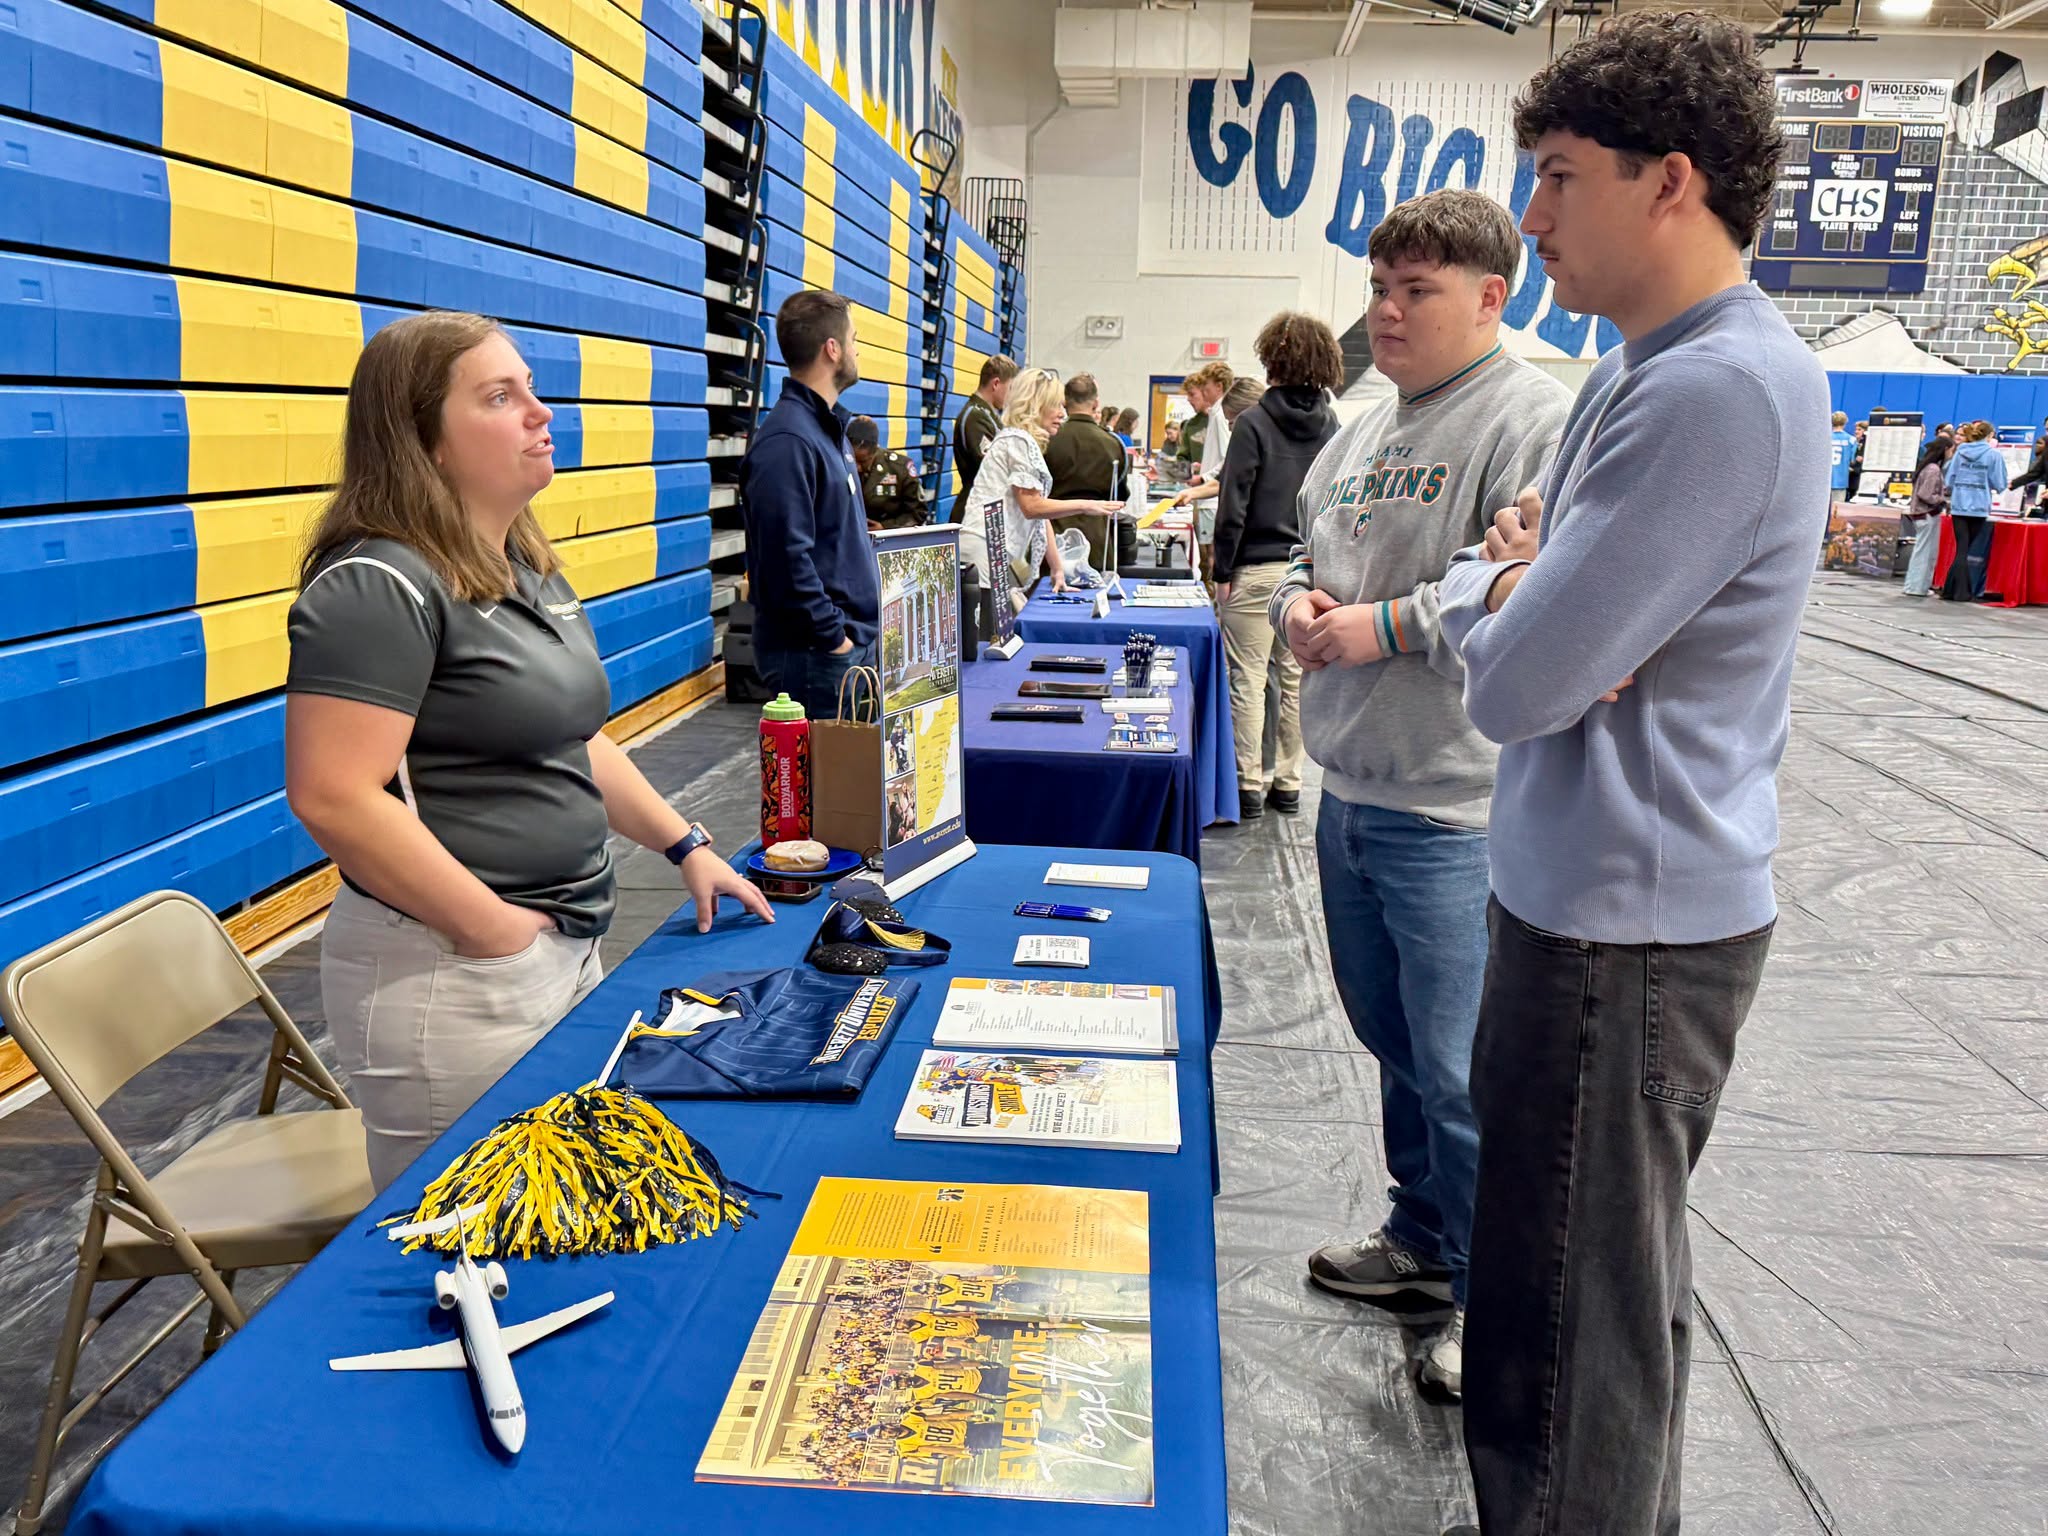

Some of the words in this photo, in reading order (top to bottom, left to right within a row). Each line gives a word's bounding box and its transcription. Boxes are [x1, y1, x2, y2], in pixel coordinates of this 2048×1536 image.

[1778, 85, 1844, 103] FirstBank
[1870, 84, 1945, 96] WHOLESOME
[1188, 58, 1317, 219] GO
[1902, 125, 1943, 137] VISITOR
[1784, 166, 1811, 175] BONUS
[1831, 161, 1860, 170] PERIOD
[1894, 168, 1922, 177] BONUS
[1894, 183, 1933, 192] TIMEOUTS
[1817, 187, 1880, 217] CHS
[1775, 209, 1795, 217] LEFT
[1900, 211, 1920, 220] LEFT
[1773, 221, 1798, 229] FOULS
[1820, 222, 1849, 230] PLAYER
[1853, 223, 1878, 231] FOULS
[1893, 223, 1918, 231] FOULS
[781, 756, 791, 818] BODYARMOR
[810, 1022, 858, 1064] AVERETT
[840, 979, 887, 1028] UNIVERSITY
[857, 996, 895, 1040] ESPORTS
[965, 1084, 990, 1125] ADMISSIONS
[997, 1088, 1020, 1112] SIMPLE
[1387, 1251, 1419, 1275] N
[962, 1283, 986, 1298] 34
[938, 1373, 964, 1391] 24
[1000, 1330, 1048, 1481] EVERYONE
[1014, 1320, 1153, 1483] Together
[924, 1425, 954, 1443] 88
